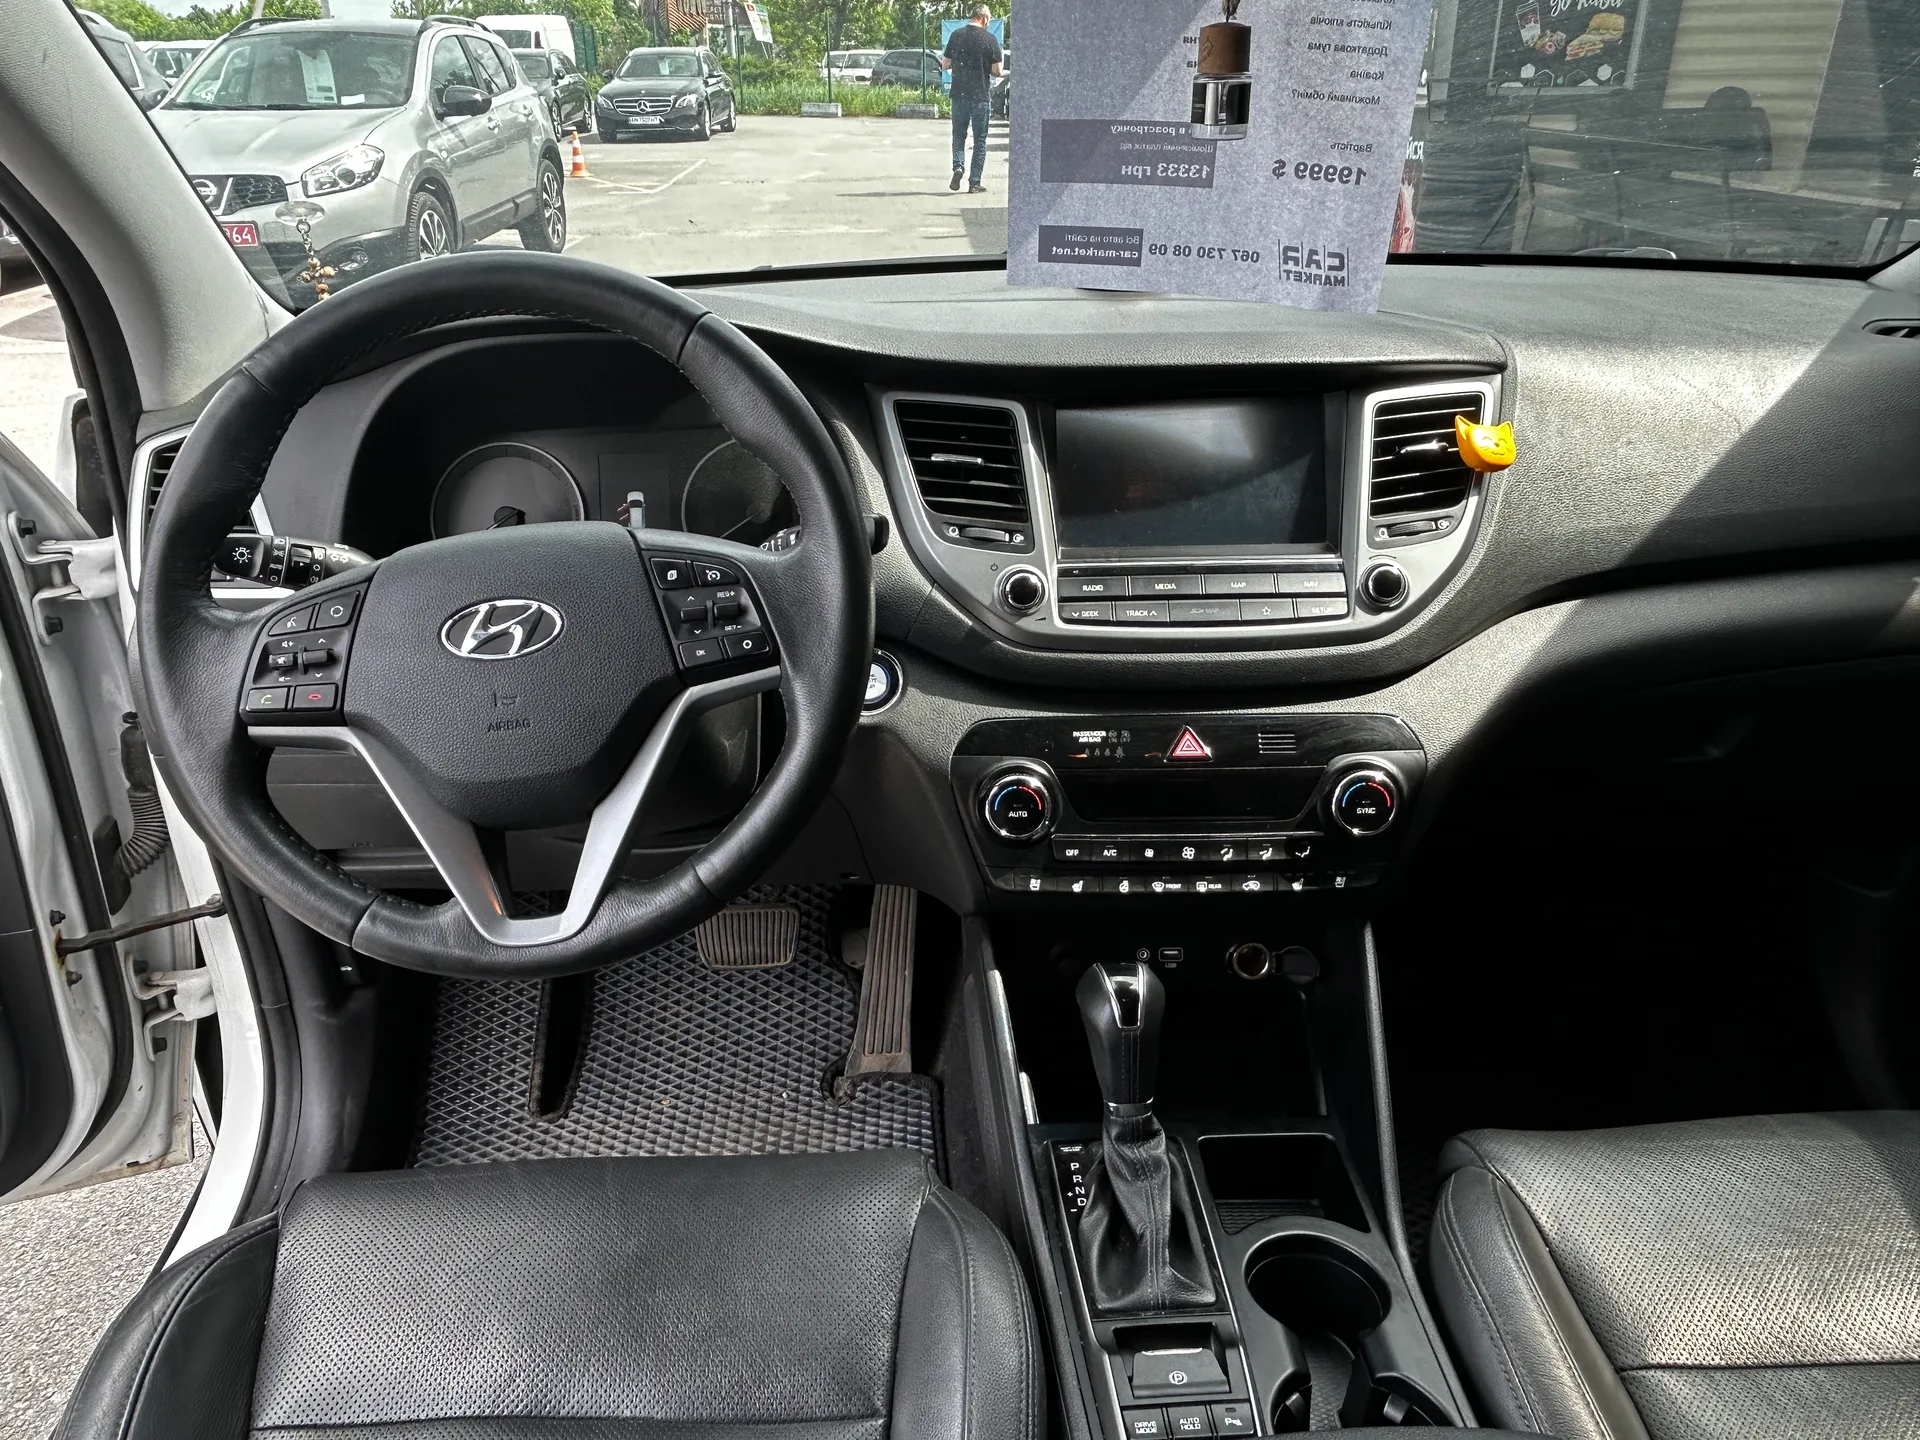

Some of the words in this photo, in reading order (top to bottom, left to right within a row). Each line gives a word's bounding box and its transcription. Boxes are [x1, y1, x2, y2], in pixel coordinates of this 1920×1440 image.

[1082, 584, 1104, 592] RADIO
[487, 719, 531, 732] AIRBAG
[1008, 810, 1028, 818] AUTO
[1070, 1162, 1080, 1171] P
[1072, 1174, 1083, 1183] R
[1075, 1186, 1086, 1195] N
[1077, 1197, 1087, 1206] D
[1134, 1420, 1157, 1428] DRIVE
[1179, 1417, 1200, 1425] AUTO
[1135, 1426, 1157, 1434] MODE
[1180, 1423, 1202, 1431] HOLD
